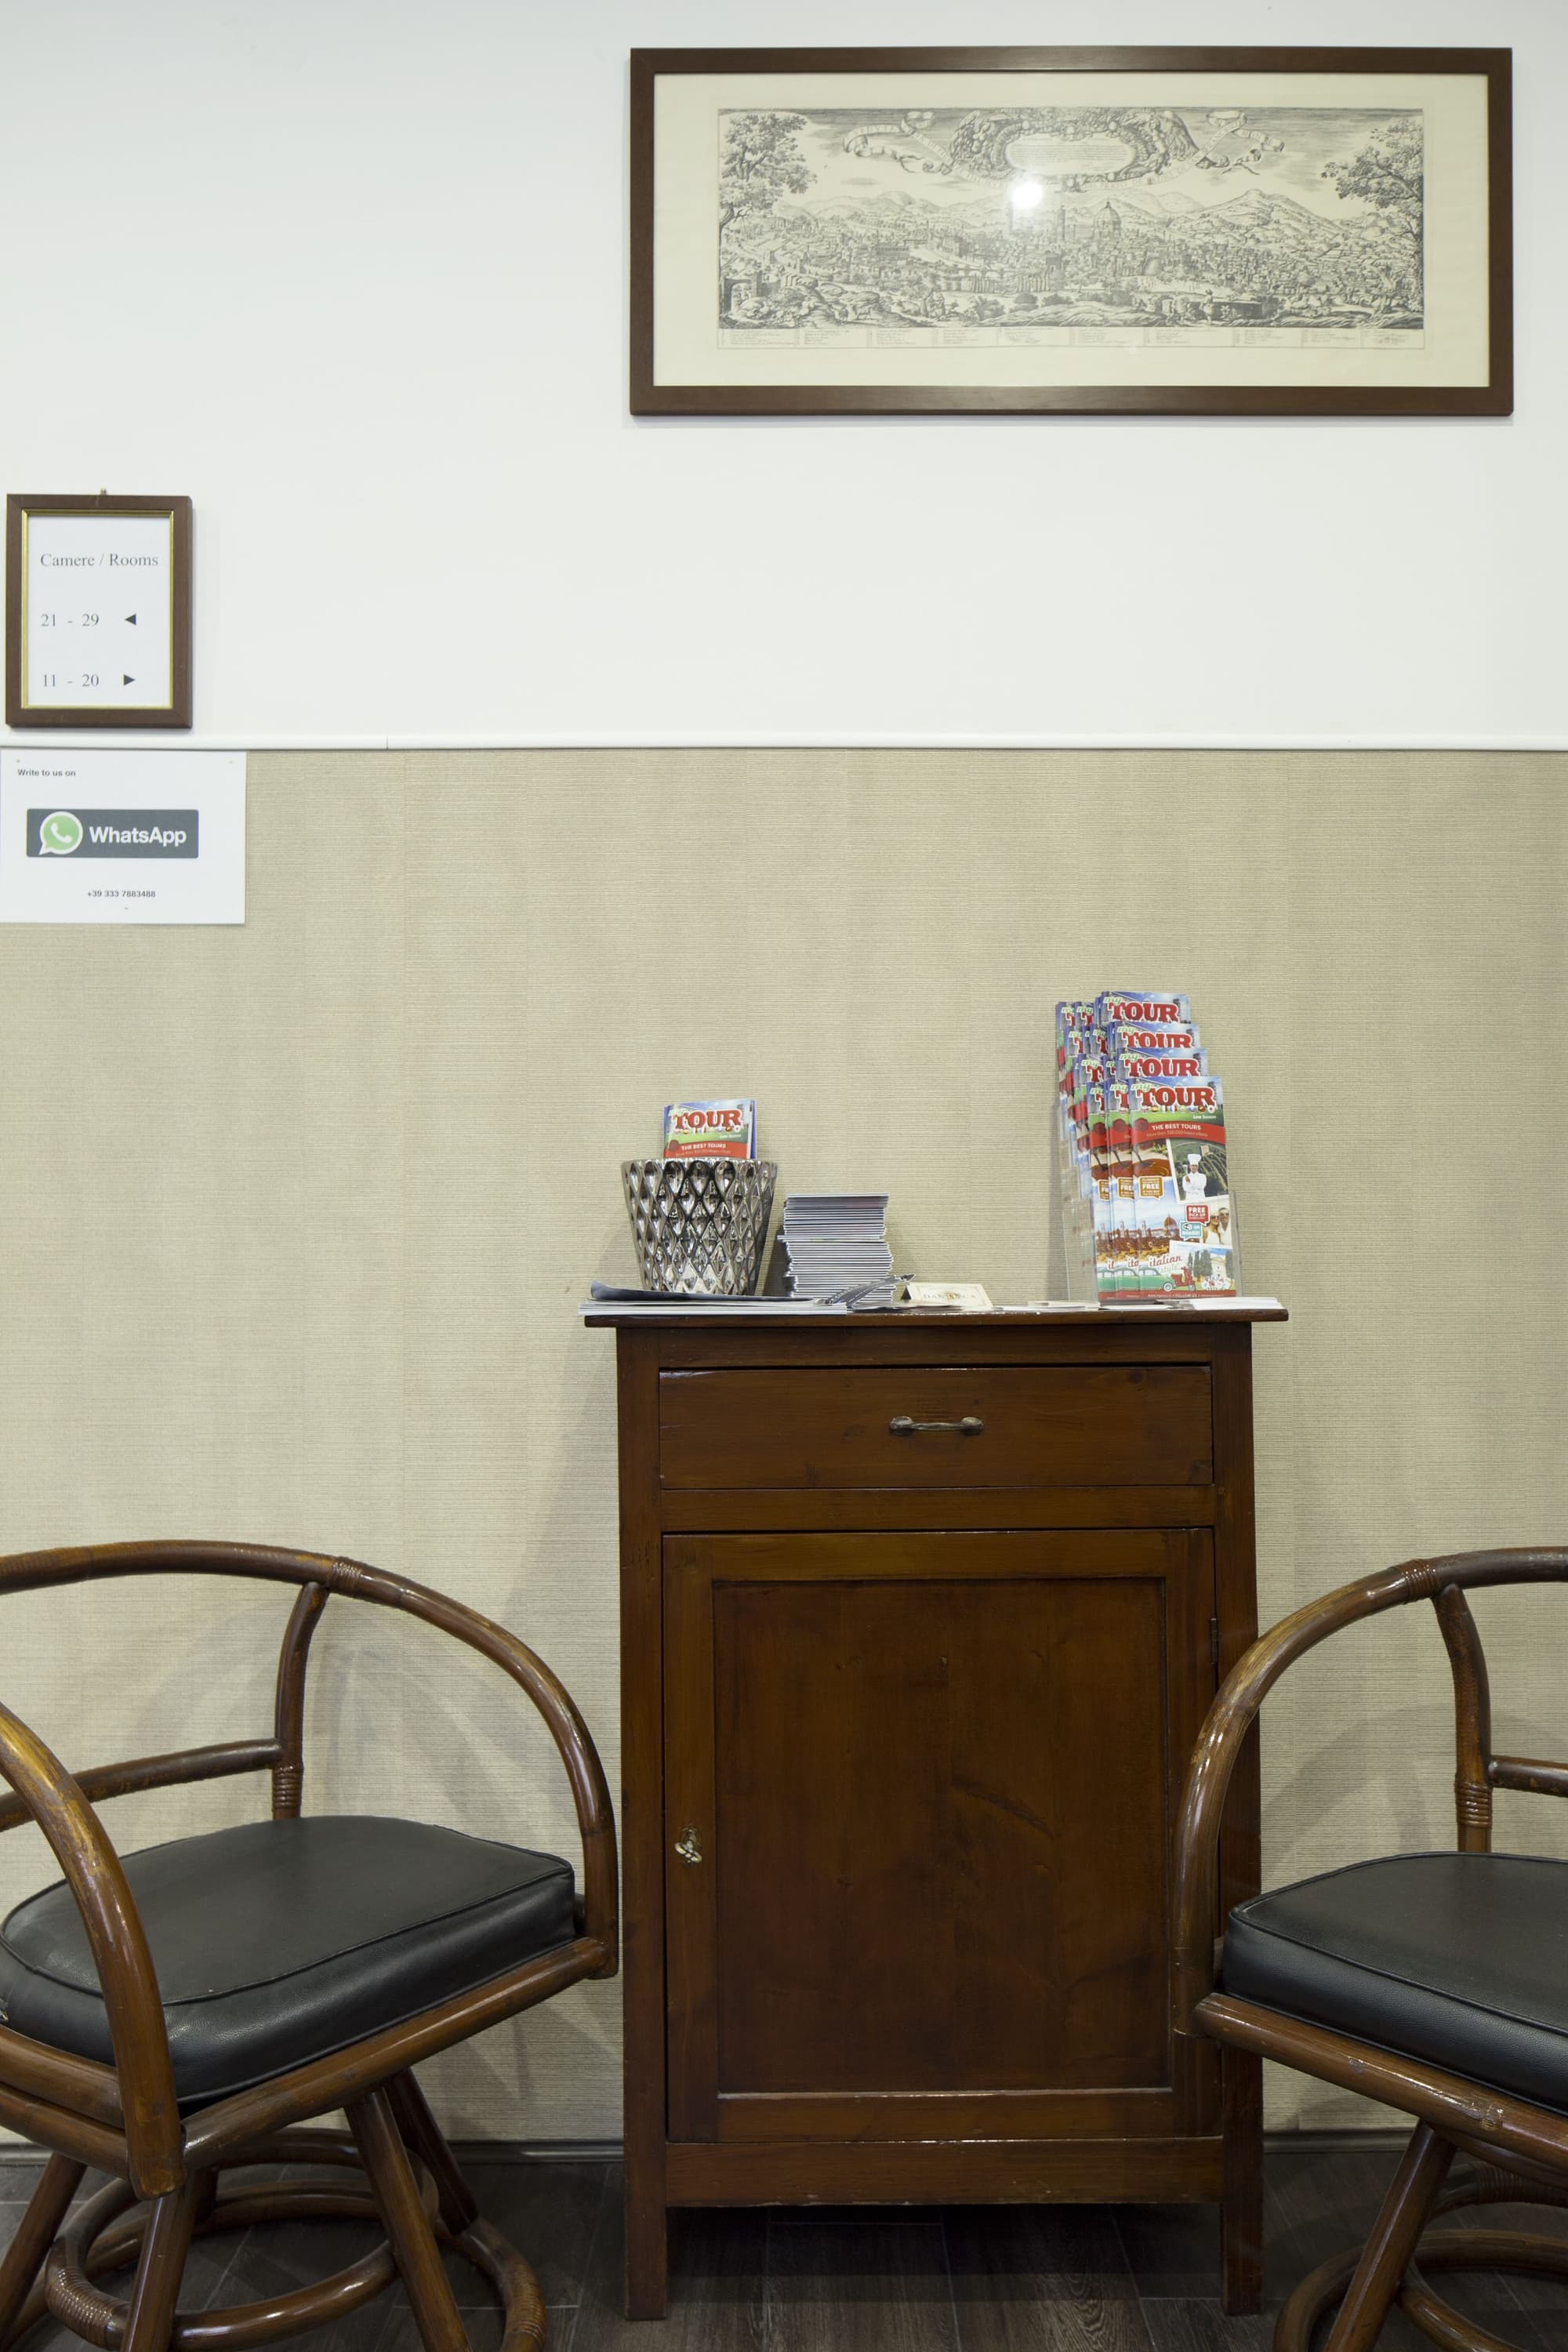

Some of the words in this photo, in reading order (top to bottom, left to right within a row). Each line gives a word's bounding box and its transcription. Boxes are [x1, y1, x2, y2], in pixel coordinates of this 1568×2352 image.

[41, 553, 95, 567] Camere
[109, 553, 159, 566] Rooms
[41, 614, 56, 626] 21
[82, 614, 100, 626] 29
[43, 674, 56, 687] 11
[82, 674, 100, 687] 20
[89, 826, 187, 847] WhatsApp
[1107, 1002, 1179, 1022] TOUR
[1122, 1032, 1192, 1048] TOUR
[1125, 1058, 1200, 1076] TOUR
[1137, 1087, 1216, 1107] TOUR
[673, 1110, 742, 1129] TOUR
[1149, 1254, 1181, 1267] italian
